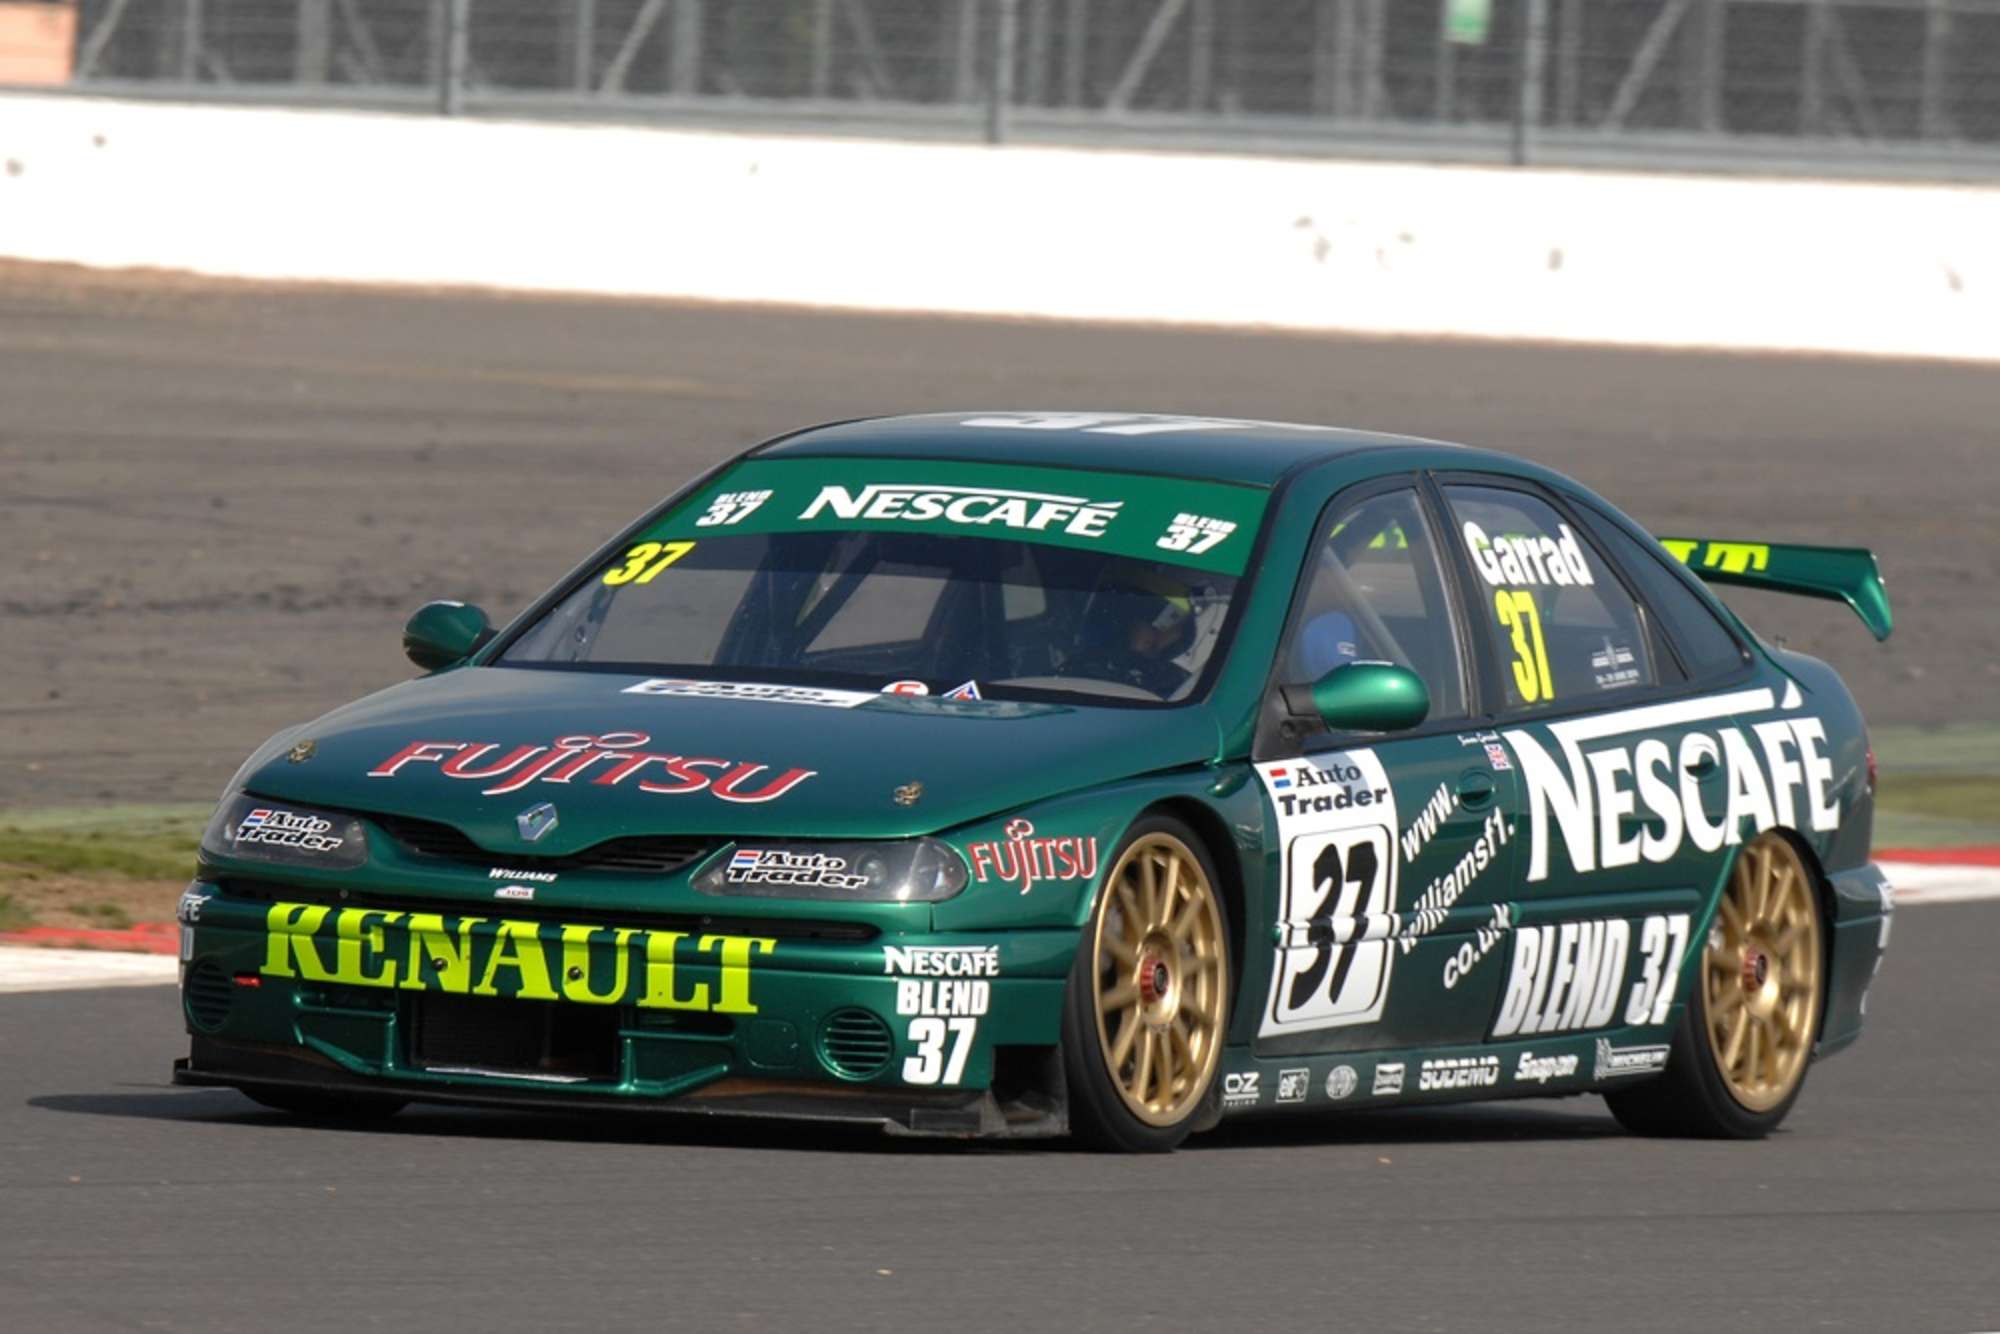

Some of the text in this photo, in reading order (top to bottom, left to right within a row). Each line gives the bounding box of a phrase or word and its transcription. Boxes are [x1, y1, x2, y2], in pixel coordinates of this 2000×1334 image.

[695, 502, 765, 527] 37
[798, 484, 1125, 537] NESCAFÉ
[1155, 523, 1229, 555] 37
[1462, 520, 1595, 587] Garrad
[602, 540, 697, 587] 37
[1494, 589, 1555, 703] 37
[367, 731, 818, 803] FUJITSU
[1295, 762, 1361, 788] Auto
[1503, 678, 1841, 883] NESCAFÉ
[266, 811, 331, 832] Auto
[1278, 786, 1387, 817] Trader
[1401, 782, 1460, 864] www.
[236, 825, 343, 851] Trader
[759, 851, 846, 871] Auto
[967, 818, 1098, 895] FUJITSU
[726, 867, 869, 889] Trader
[1287, 840, 1379, 1011] 37
[259, 901, 778, 1015] RENAULT
[883, 944, 1000, 977] NESCAFÉ
[1491, 913, 1690, 1038] BLEND 37
[896, 979, 990, 1017] BLEND
[901, 1016, 978, 1086] 37
[1225, 1072, 1260, 1094] OZ
